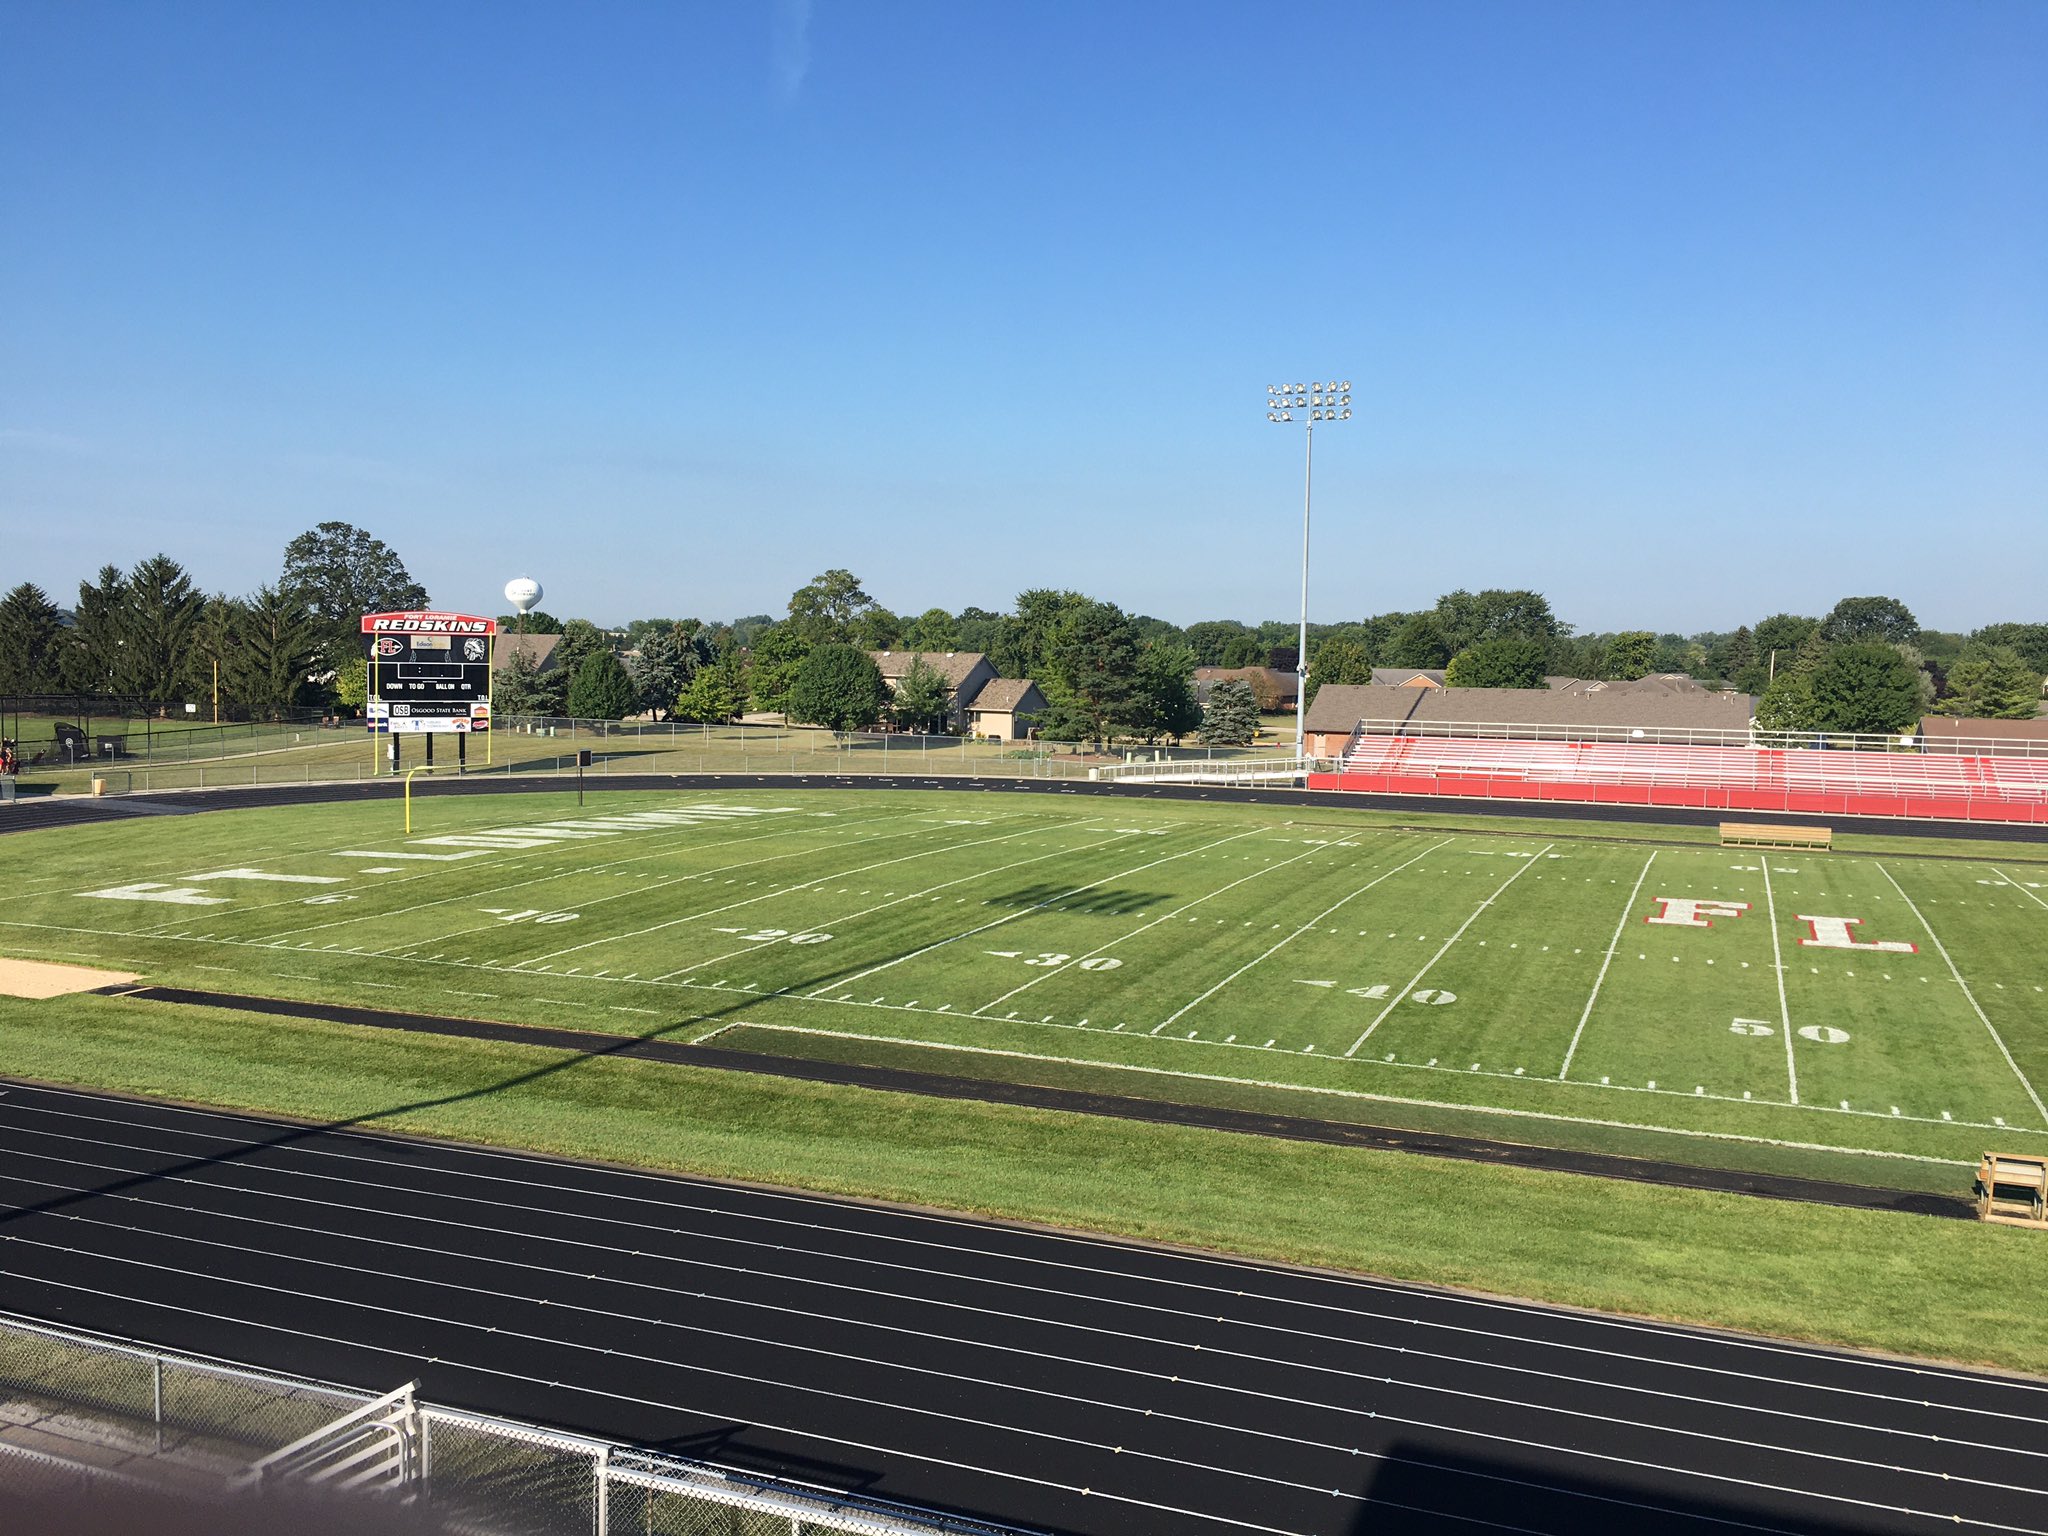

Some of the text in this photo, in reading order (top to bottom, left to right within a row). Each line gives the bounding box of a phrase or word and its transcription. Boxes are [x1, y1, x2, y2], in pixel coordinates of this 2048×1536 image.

[372, 619, 487, 633] REDSKINS
[394, 705, 409, 715] OSB
[328, 804, 803, 861] LORAMIE
[497, 909, 580, 924] 10
[737, 929, 834, 945] 20
[1023, 952, 1123, 972] 30
[1345, 984, 1458, 1006] 40
[1729, 1018, 1850, 1044] 50
